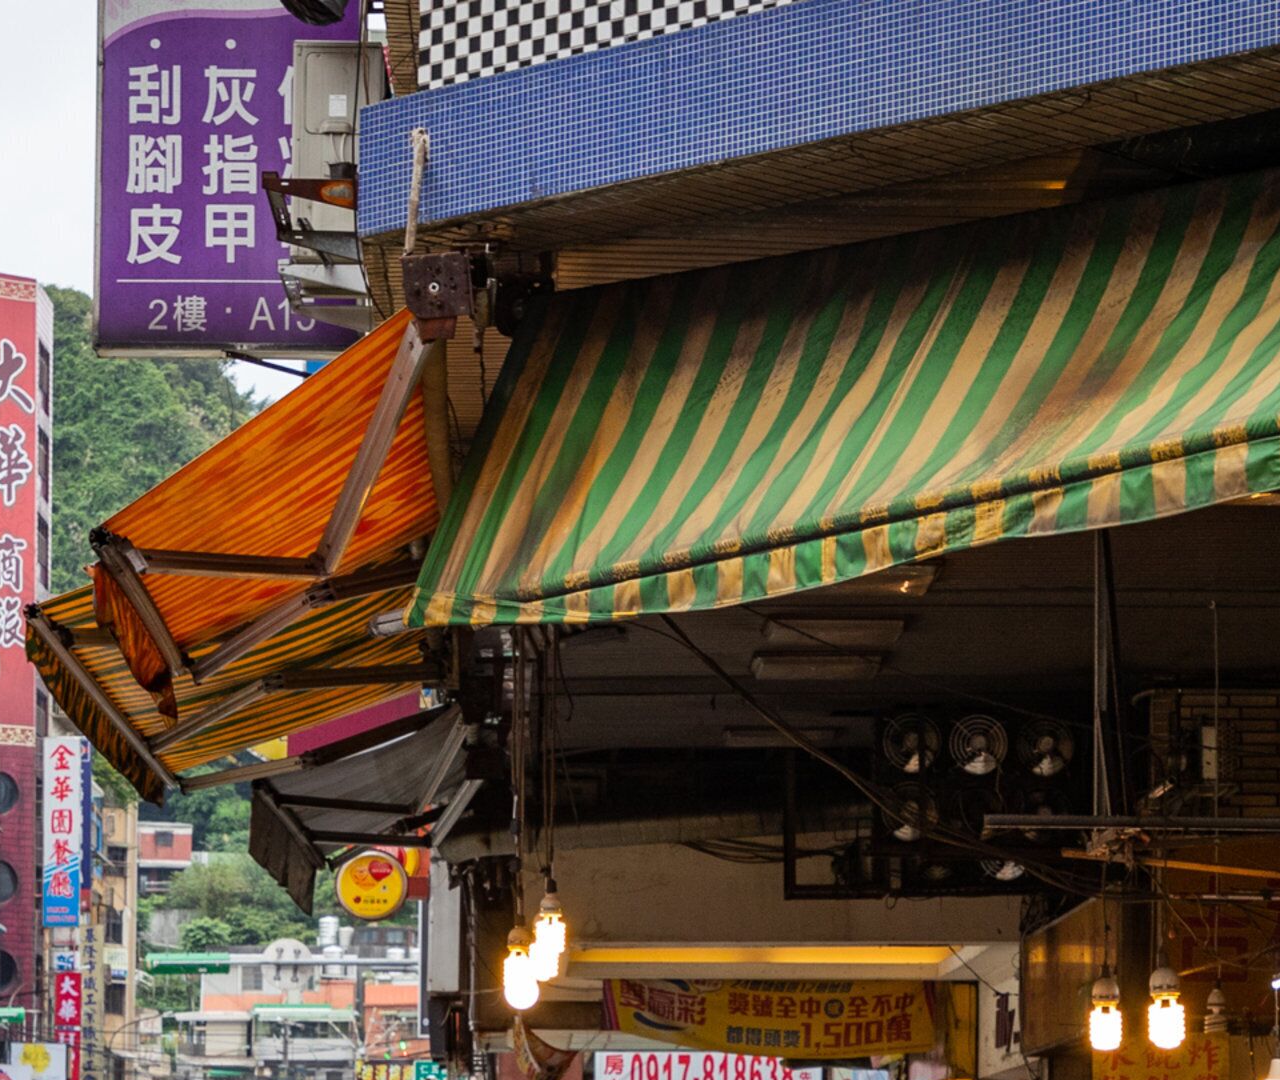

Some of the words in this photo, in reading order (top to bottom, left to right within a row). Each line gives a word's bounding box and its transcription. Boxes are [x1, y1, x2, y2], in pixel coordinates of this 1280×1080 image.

[126, 64, 183, 265] 刮腳皮
[202, 64, 259, 265] 灰指甲
